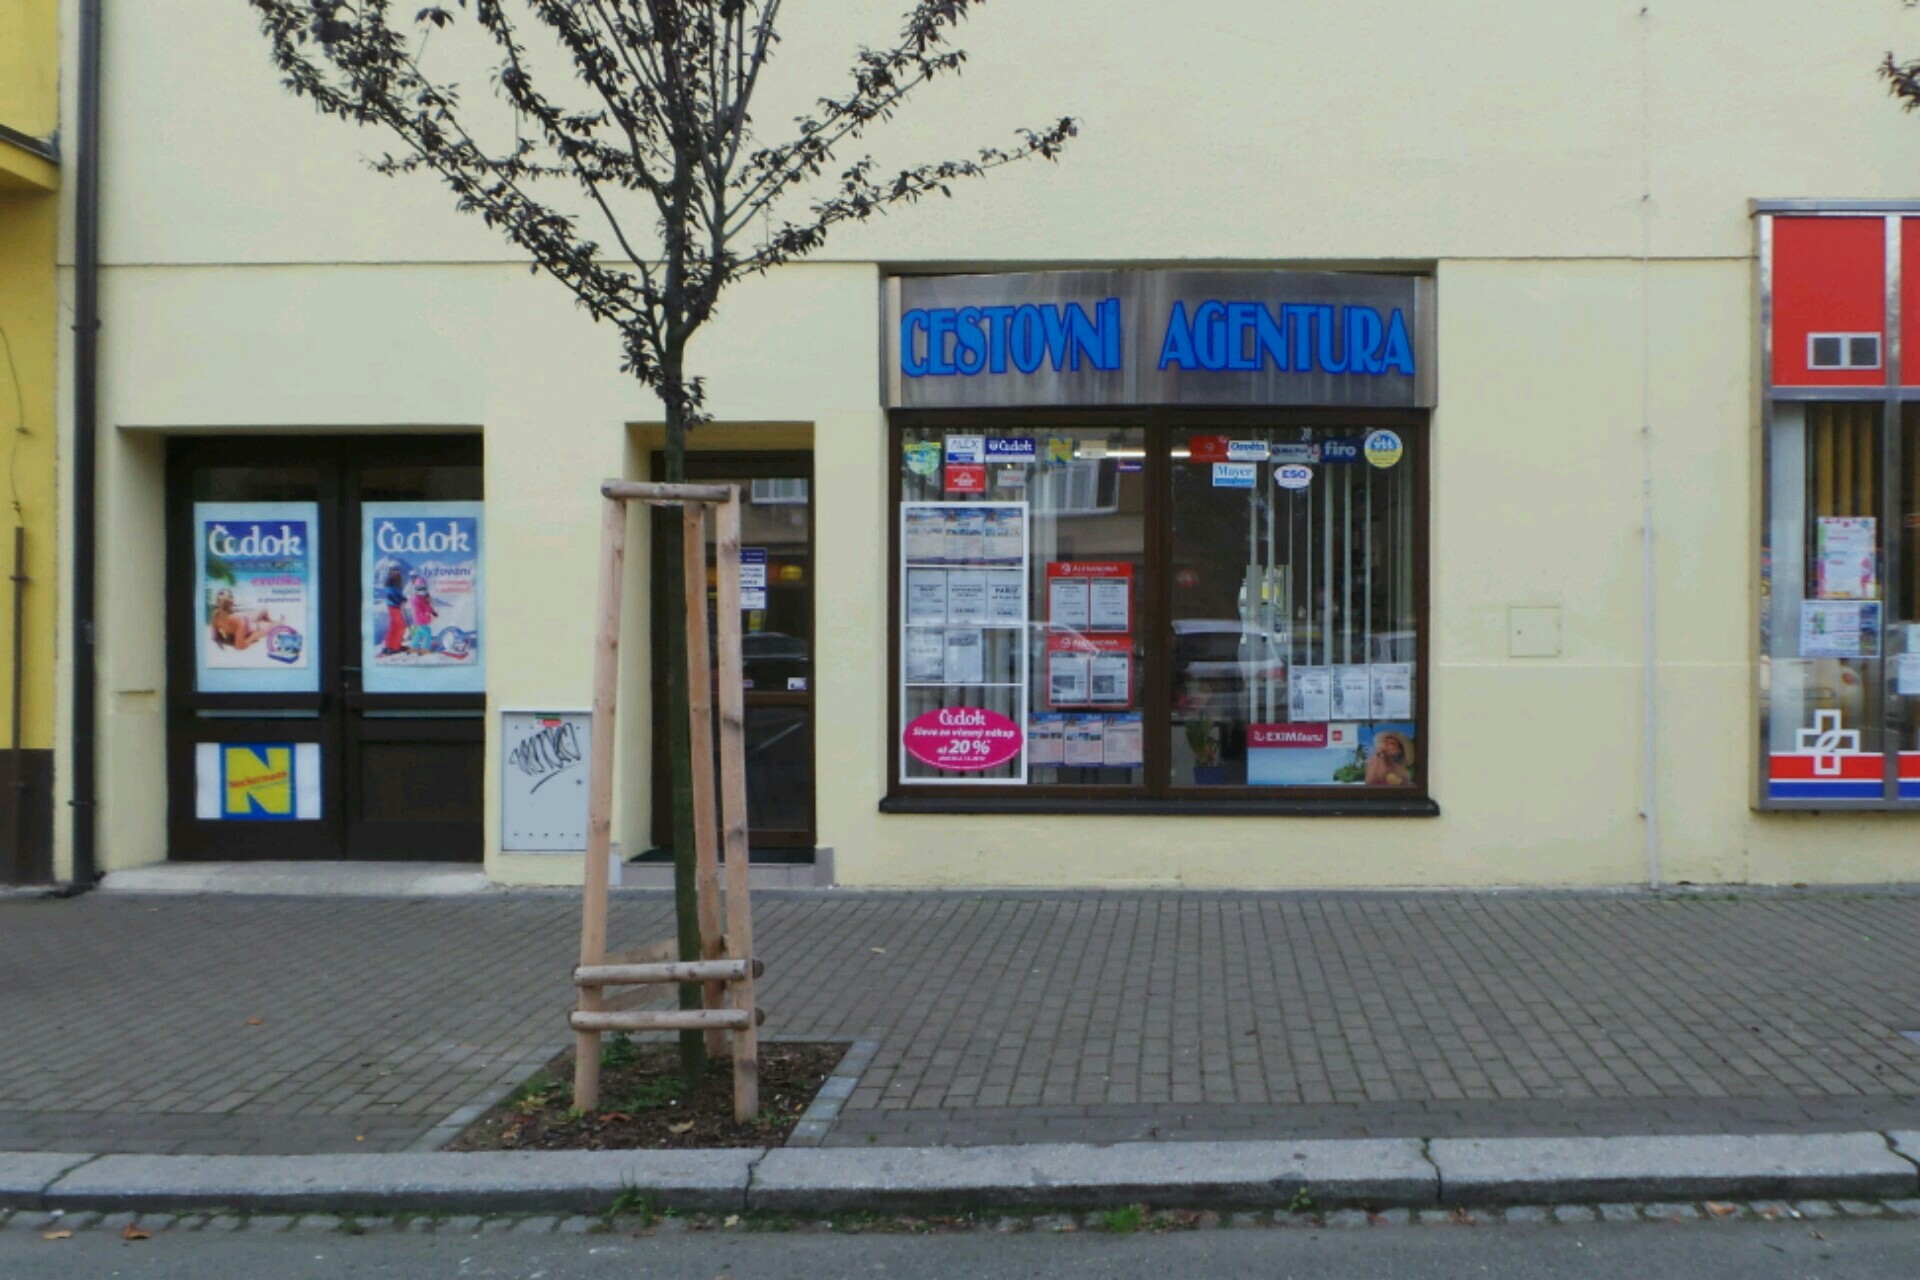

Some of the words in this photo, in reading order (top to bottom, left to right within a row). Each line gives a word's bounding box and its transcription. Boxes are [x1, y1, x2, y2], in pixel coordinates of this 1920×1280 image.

[900, 297, 1121, 377] CESTOVNÍ
[1157, 300, 1415, 376] AGENTURA
[1324, 440, 1357, 457] firo
[208, 524, 303, 557] Čedok
[377, 520, 471, 553] Čedok
[939, 708, 987, 726] Čedok
